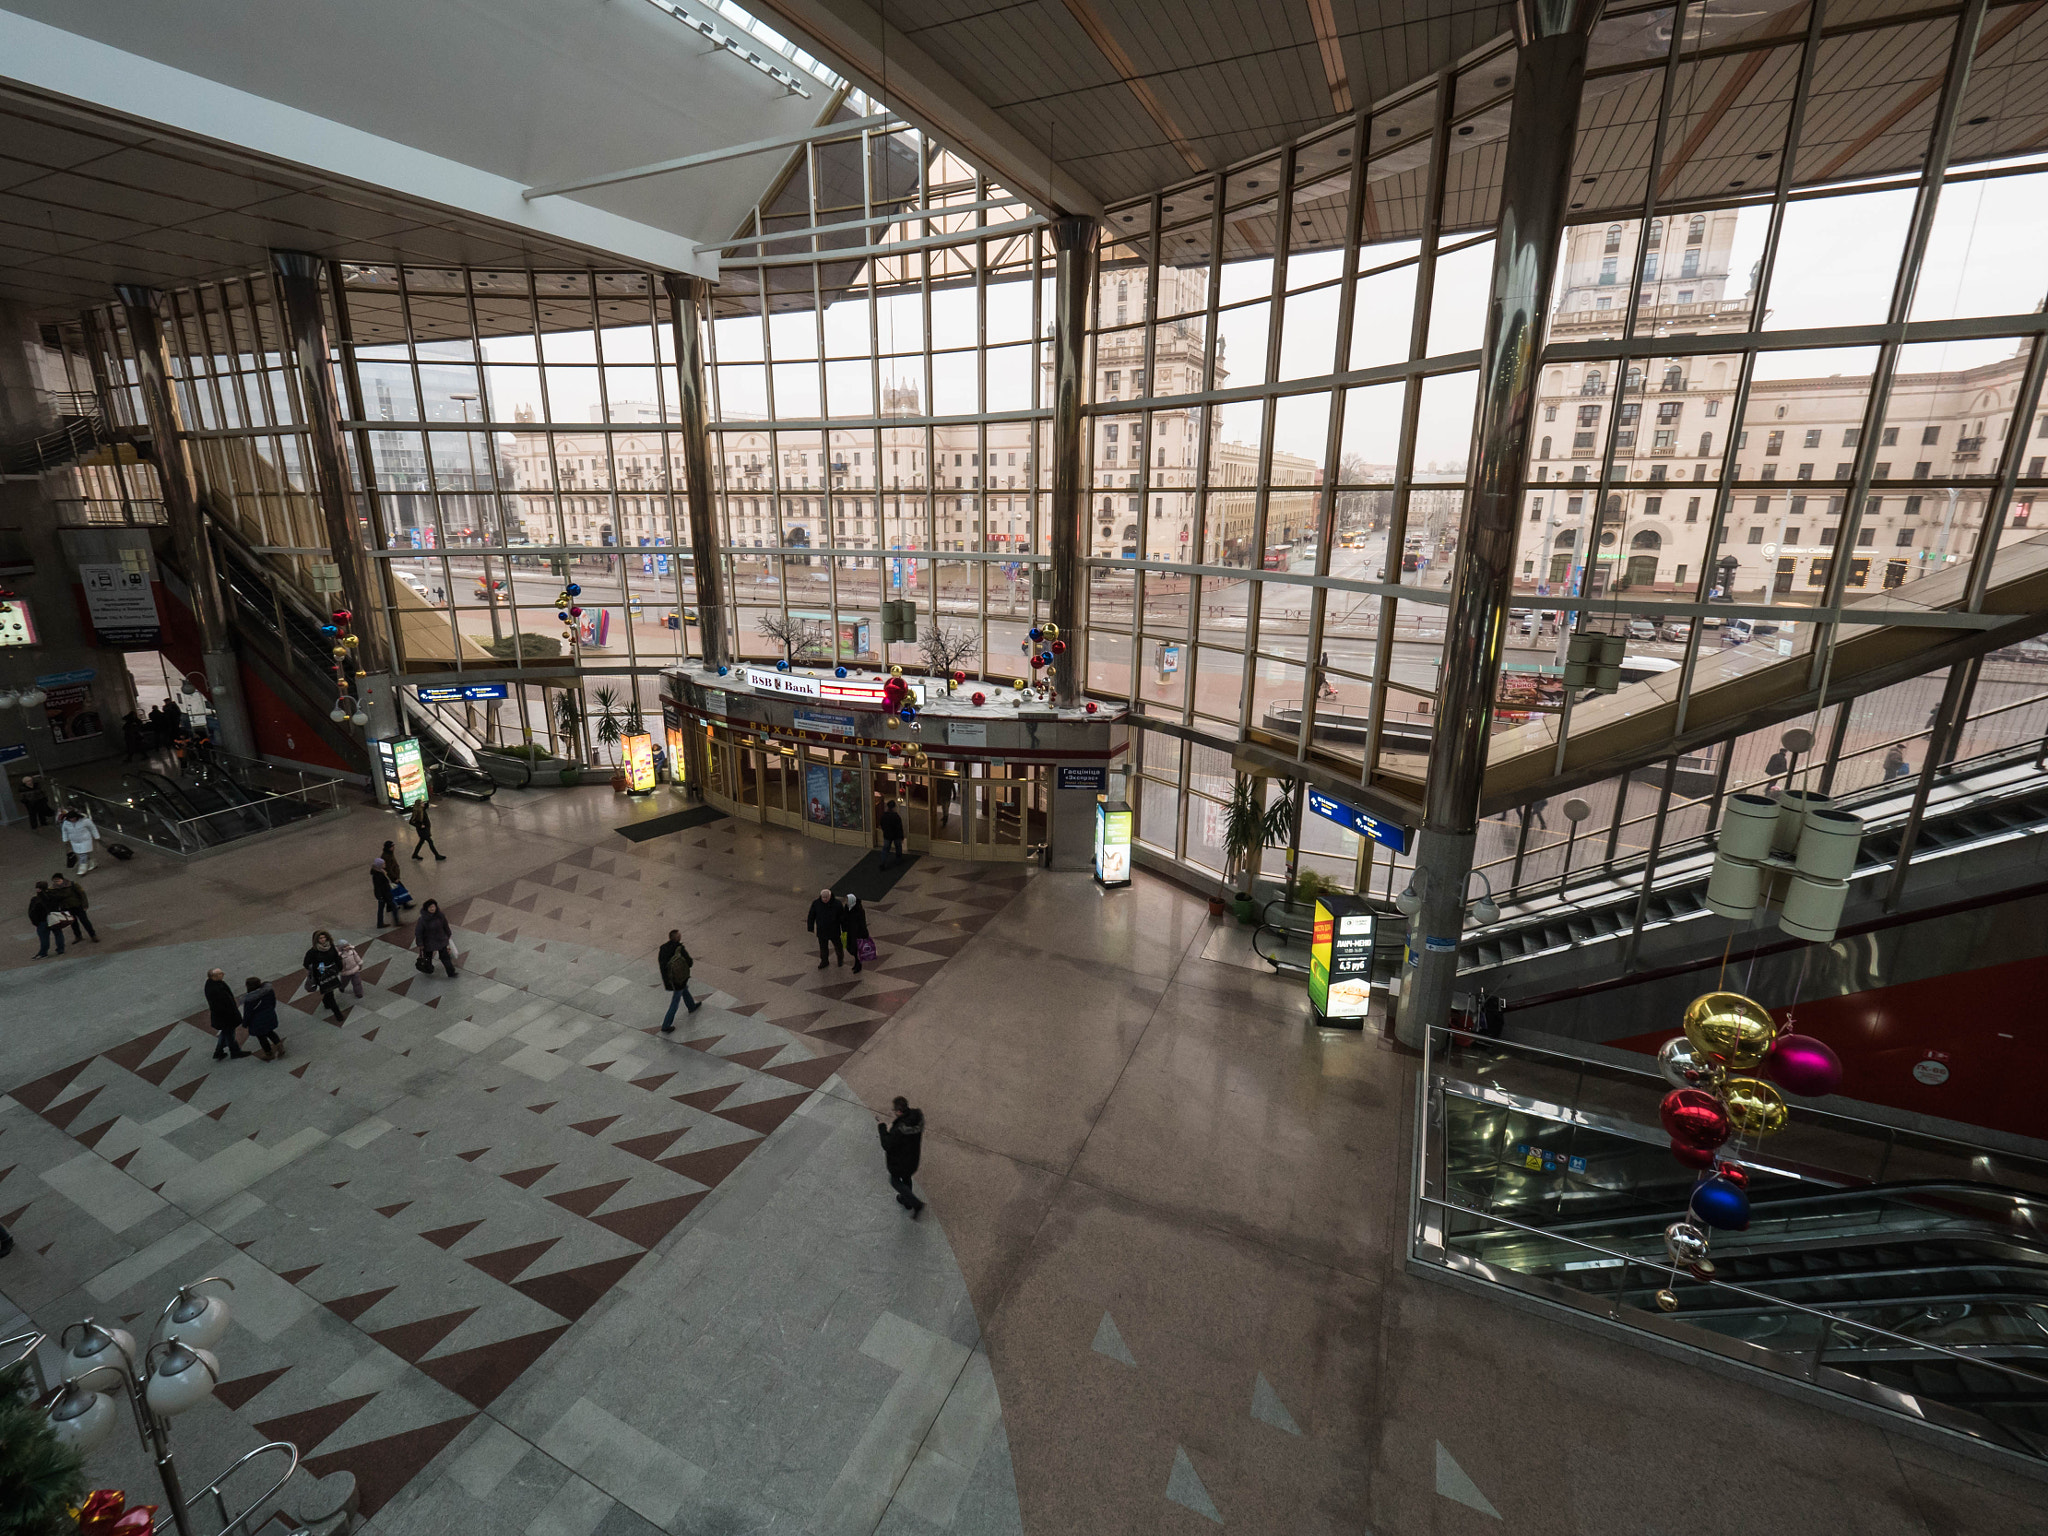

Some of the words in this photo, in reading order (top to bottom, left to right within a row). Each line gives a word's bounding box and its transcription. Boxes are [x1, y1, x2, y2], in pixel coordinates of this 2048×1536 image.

[751, 674, 772, 687] BSB
[784, 680, 814, 694] Bank
[750, 721, 807, 739] ВЫХАД
[820, 733, 829, 742] У
[842, 735, 909, 750] ГОРАД
[1336, 938, 1372, 948] ЛАНЧ-МЕНЮ
[1339, 961, 1351, 970] 6,5
[1352, 960, 1365, 971] руб
